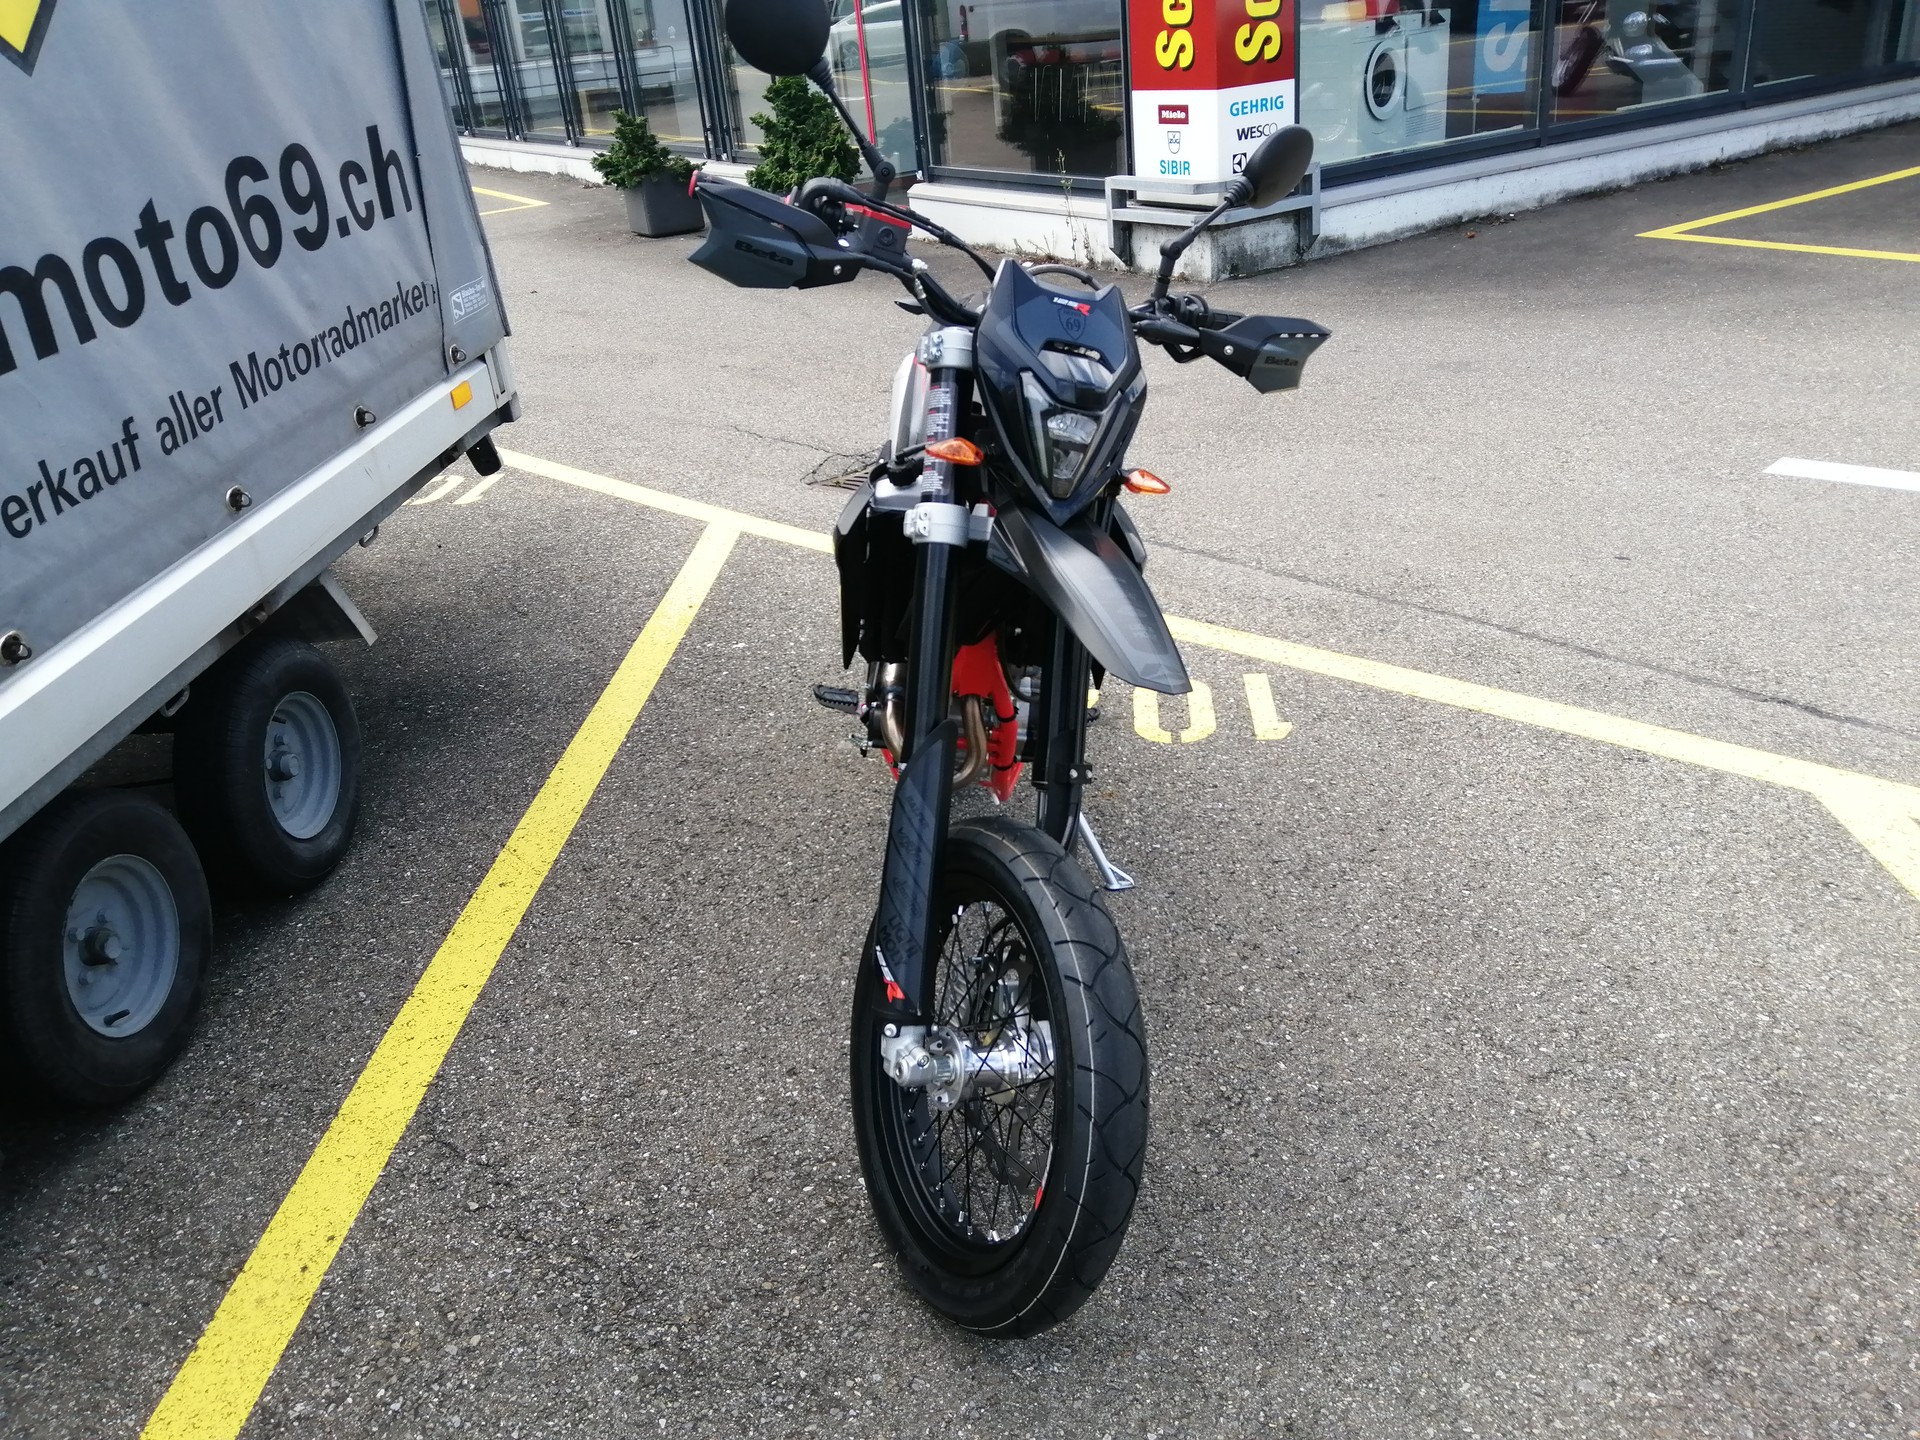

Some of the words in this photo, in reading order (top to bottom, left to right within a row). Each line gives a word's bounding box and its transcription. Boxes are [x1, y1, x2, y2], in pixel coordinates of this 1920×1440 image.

[1161, 110, 1186, 119] Miele
[1229, 95, 1285, 117] GEHRIG
[1236, 122, 1278, 141] WESCO
[1159, 160, 1190, 175] SIBIR
[735, 239, 793, 266] Beta
[1066, 317, 1081, 331] 69
[1264, 356, 1298, 367] Beta
[155, 386, 224, 456] aller
